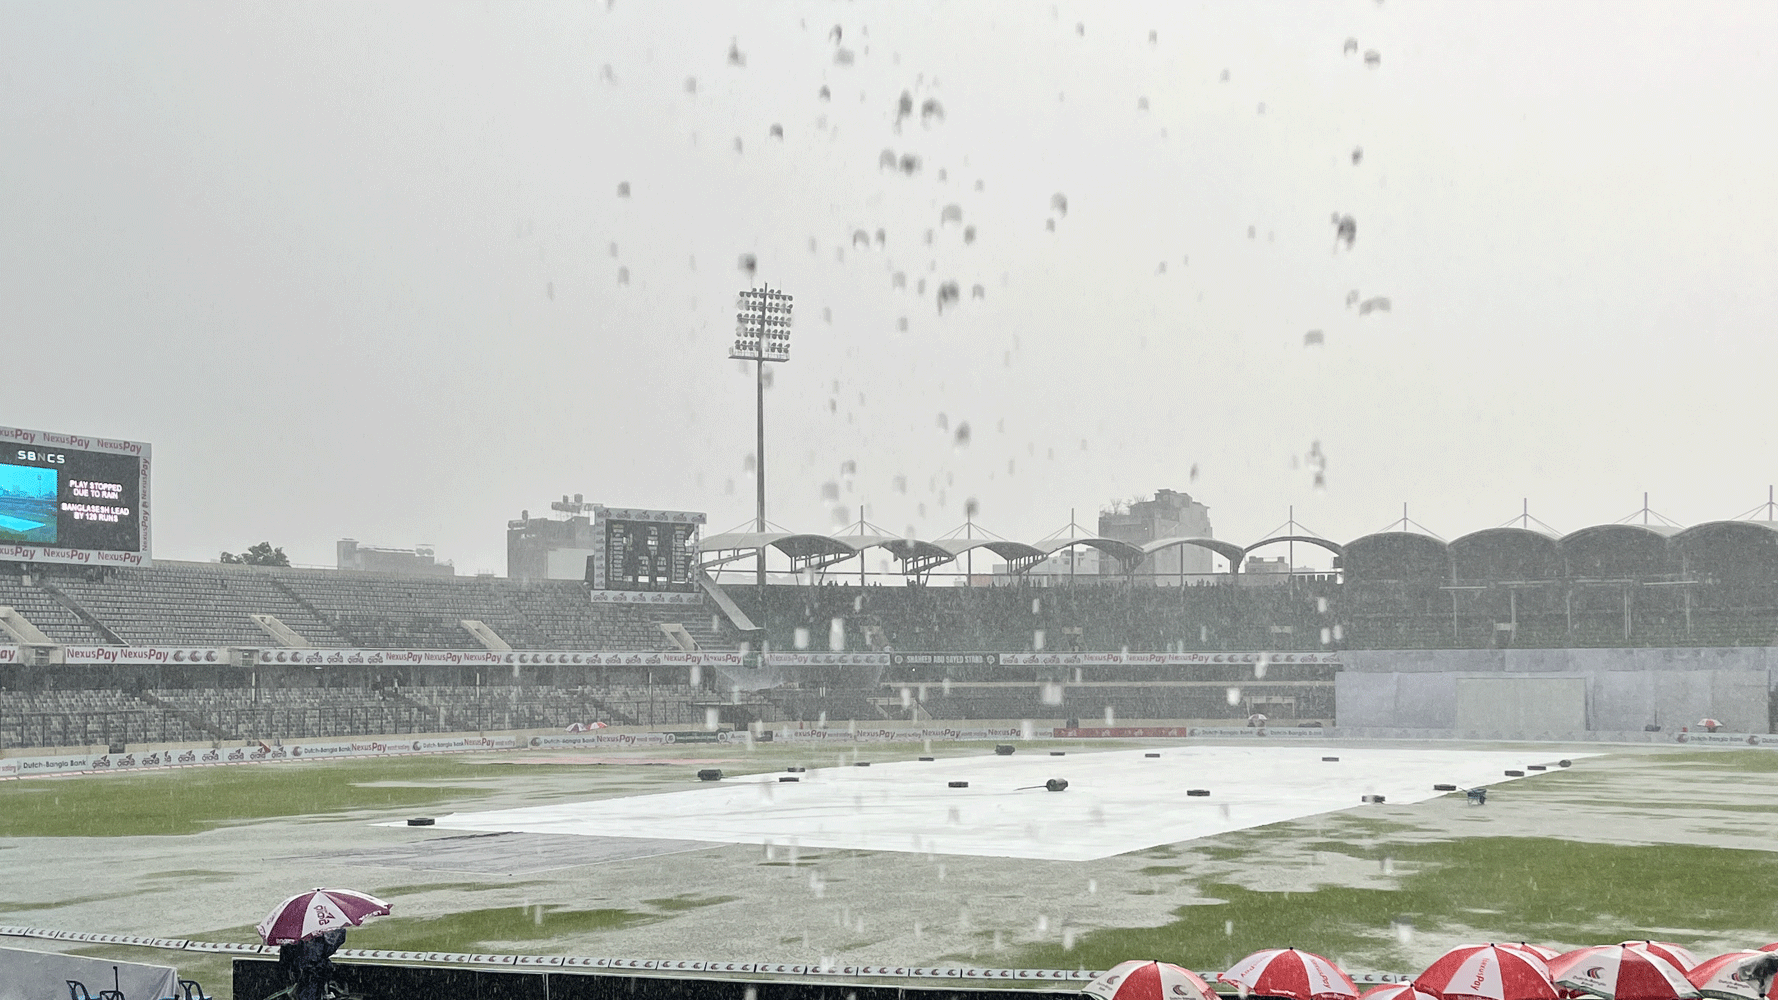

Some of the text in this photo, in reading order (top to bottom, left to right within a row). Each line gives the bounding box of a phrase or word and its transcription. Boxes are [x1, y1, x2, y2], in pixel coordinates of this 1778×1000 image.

[43, 433, 90, 449] NexusPay
[97, 439, 142, 455] NexusPay
[141, 458, 150, 500] NexusPay
[69, 480, 122, 492] PLAY STOPPED
[73, 488, 89, 497] DUE
[102, 491, 118, 499] RAIN
[111, 507, 130, 515] LEAD
[98, 514, 118, 522] RUNS
[141, 510, 150, 551] NexusPay
[43, 548, 90, 562] NexusPay
[97, 552, 142, 565] NexusPay
[67, 648, 169, 662] NexusPay NexusPay
[386, 652, 423, 664] NexusPay
[424, 652, 463, 664] NexusPay
[464, 652, 502, 664] NexusPay
[664, 654, 702, 664] NexusPay
[704, 654, 742, 664] NexusPay
[769, 654, 808, 663] NexusPay
[1084, 654, 1123, 664] NexusPay
[1127, 654, 1167, 664] NexusPay
[1168, 654, 1209, 663] NexusPay
[857, 729, 896, 739] NexusPay
[922, 729, 961, 738] NexusPay
[464, 738, 495, 748] NexusPay
[596, 735, 636, 744] NexusPay
[351, 743, 387, 753] NexusPay
[23, 761, 69, 769] Dutch-Bangla
